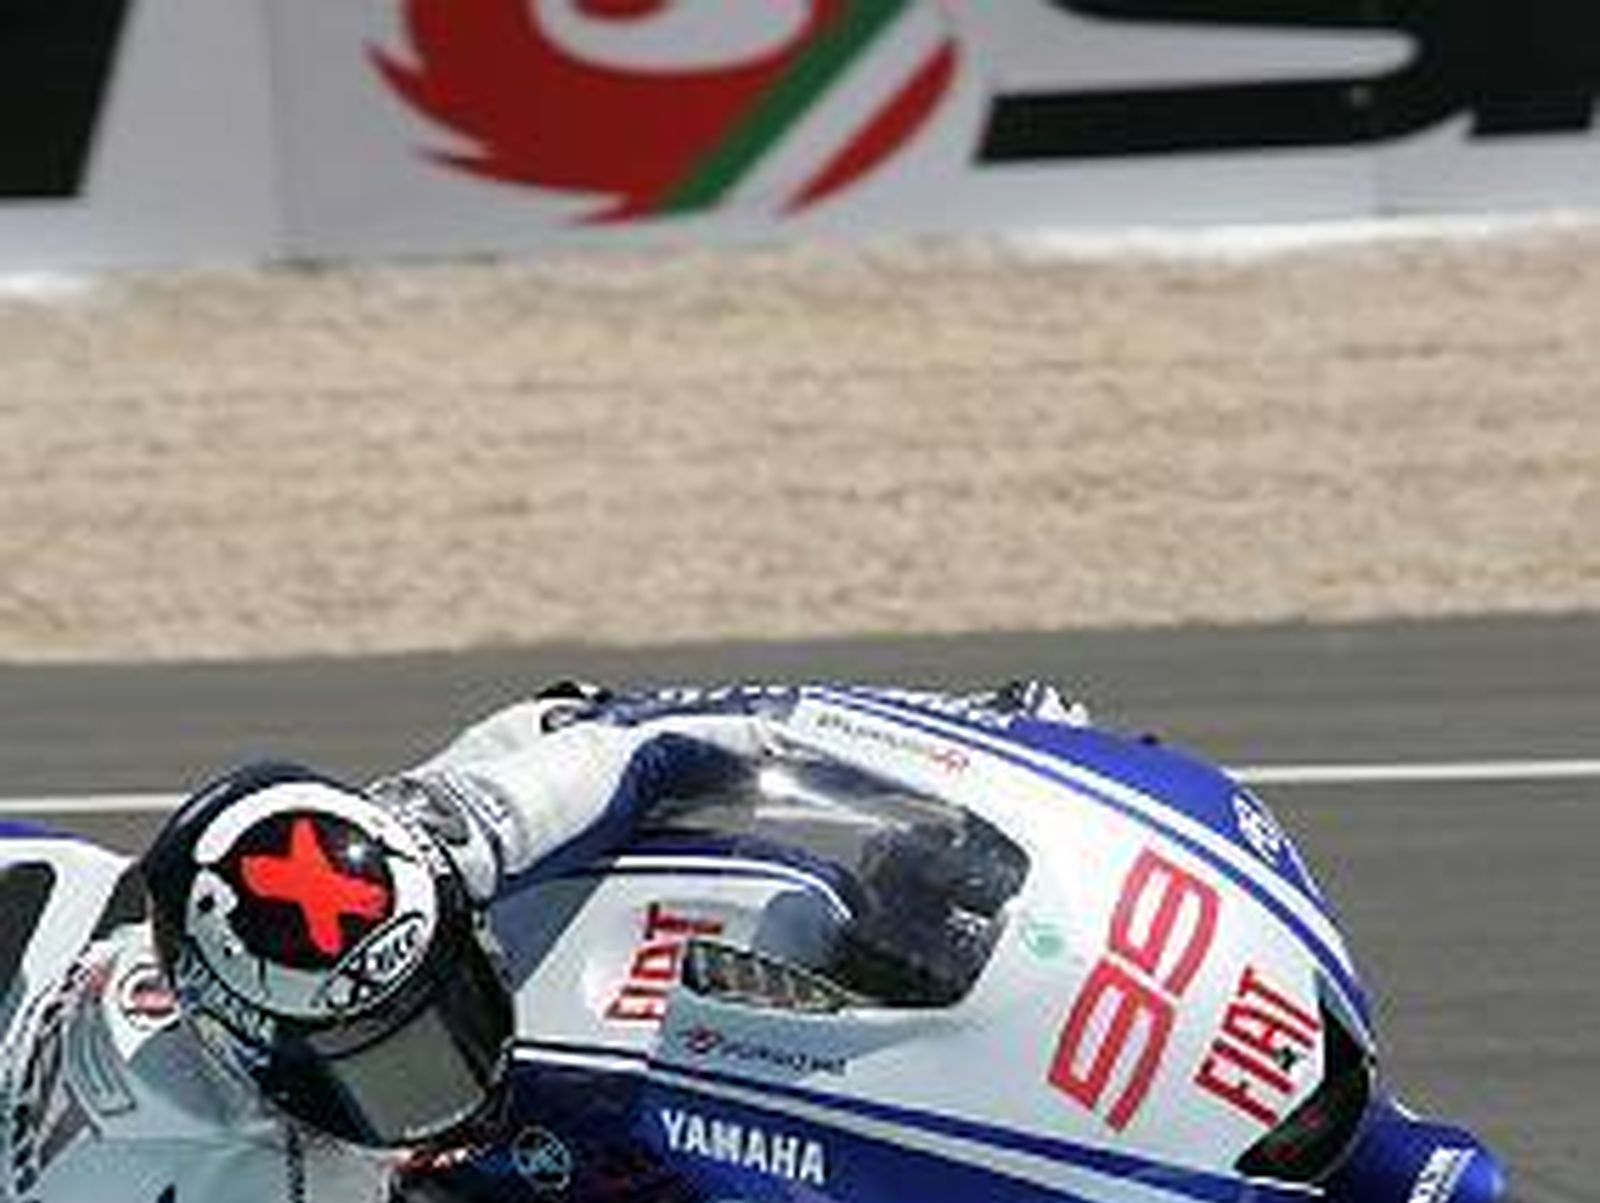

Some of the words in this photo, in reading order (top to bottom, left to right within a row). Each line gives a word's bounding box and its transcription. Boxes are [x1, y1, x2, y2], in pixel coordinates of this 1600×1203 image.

[1046, 847, 1220, 1133] 99
[1193, 963, 1321, 1128] FIAT
[661, 1108, 825, 1186] YAMAHA
